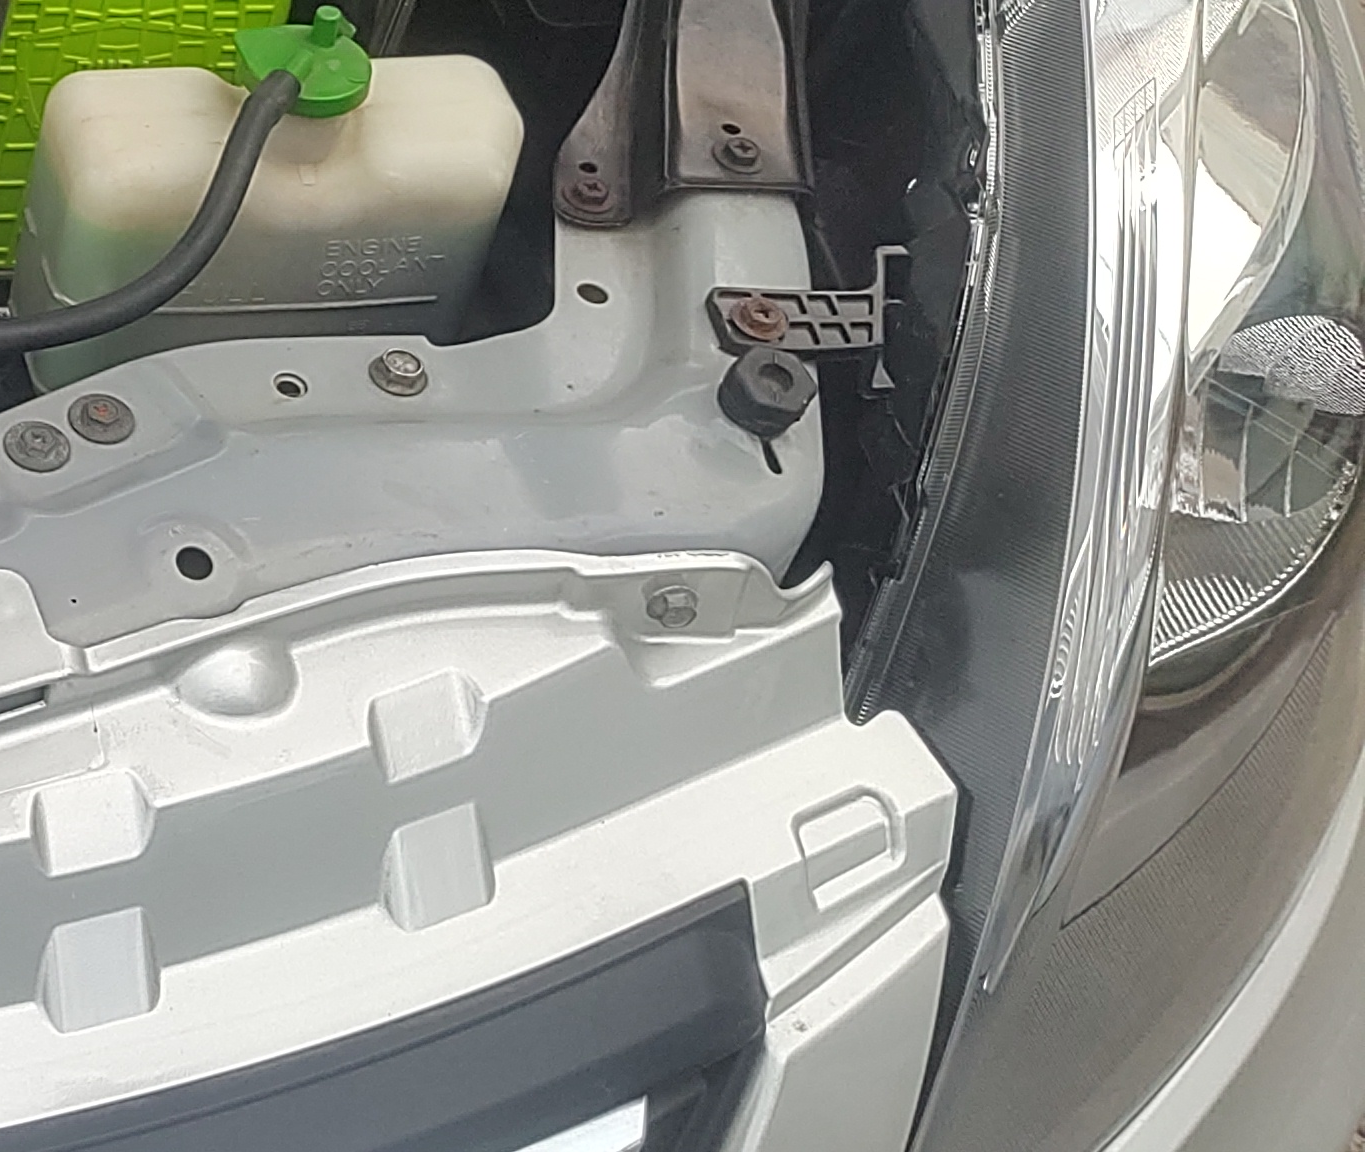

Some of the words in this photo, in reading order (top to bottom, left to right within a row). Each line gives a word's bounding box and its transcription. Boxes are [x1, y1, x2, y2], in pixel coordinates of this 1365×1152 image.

[325, 235, 422, 258] ENGINE
[320, 253, 446, 278] COOLANT
[317, 277, 385, 297] ONLY
